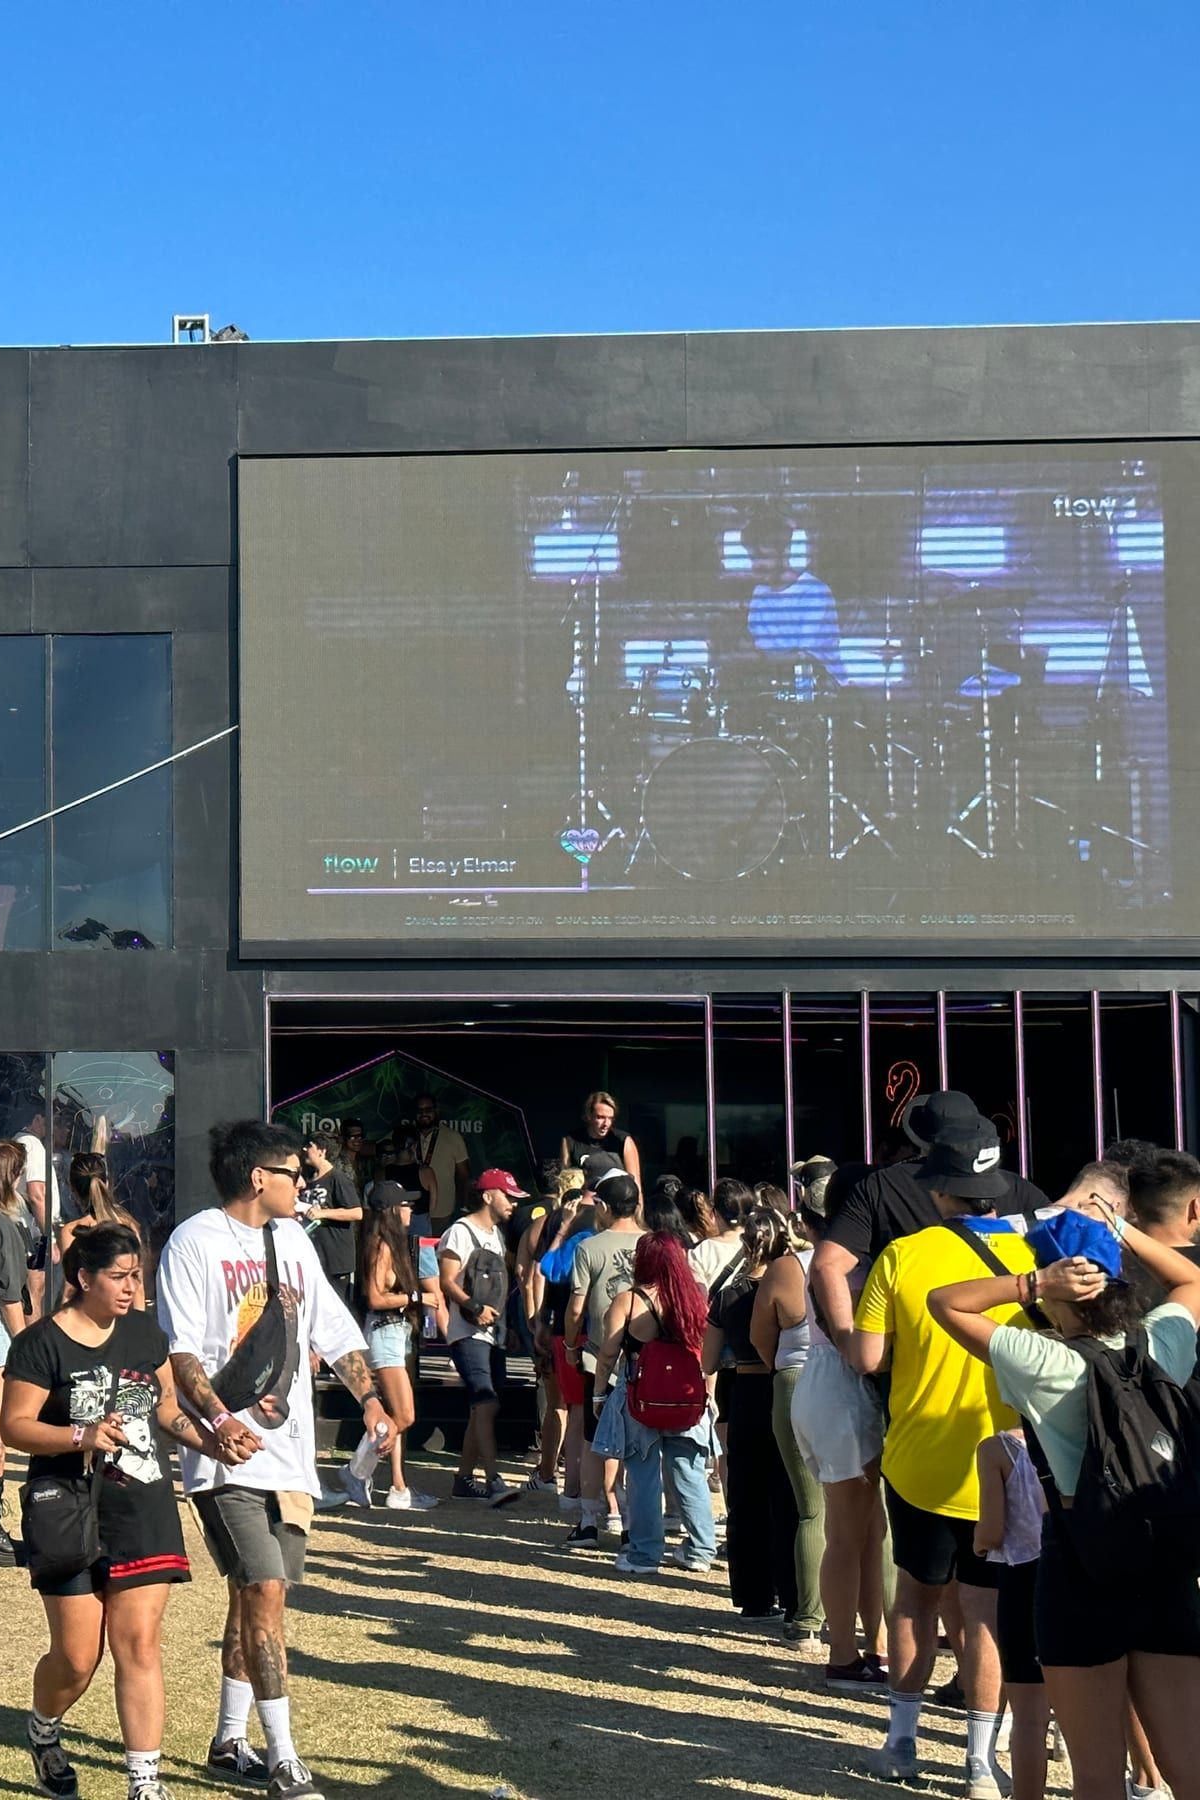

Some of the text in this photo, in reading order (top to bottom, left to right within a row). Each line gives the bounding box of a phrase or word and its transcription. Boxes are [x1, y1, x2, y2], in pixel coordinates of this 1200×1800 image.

[1053, 494, 1116, 520] flow
[324, 855, 517, 877] flow Elsa y Elmar
